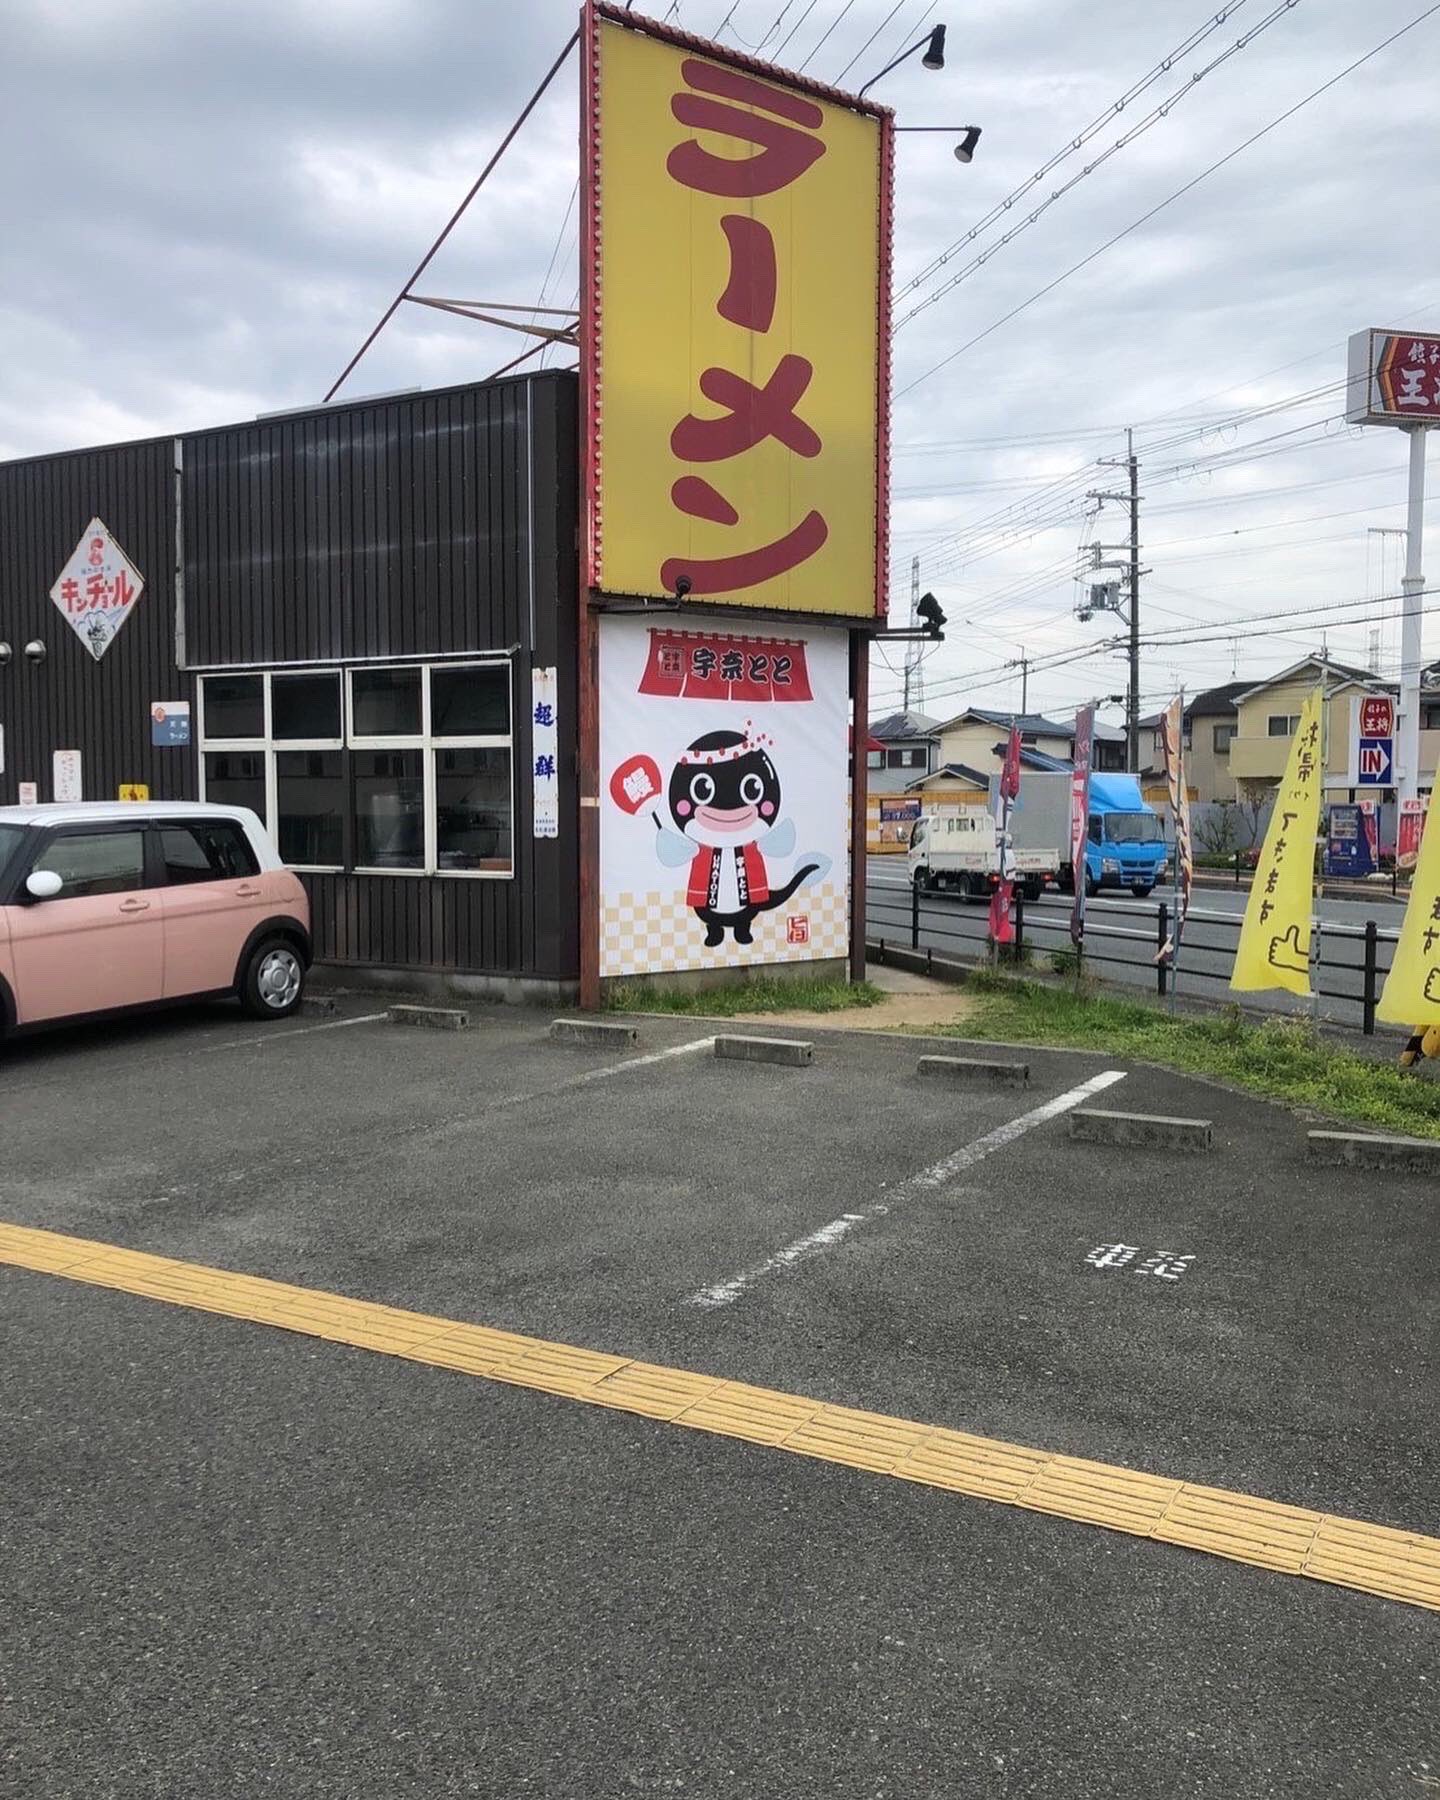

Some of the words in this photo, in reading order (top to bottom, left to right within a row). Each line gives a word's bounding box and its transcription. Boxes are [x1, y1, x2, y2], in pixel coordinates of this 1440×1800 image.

[661, 58, 829, 595] ラーメン
[60, 569, 135, 613] キンチョール
[692, 647, 792, 684] 宇奈とと
[1364, 717, 1389, 732] 王将
[1362, 750, 1382, 772] IN
